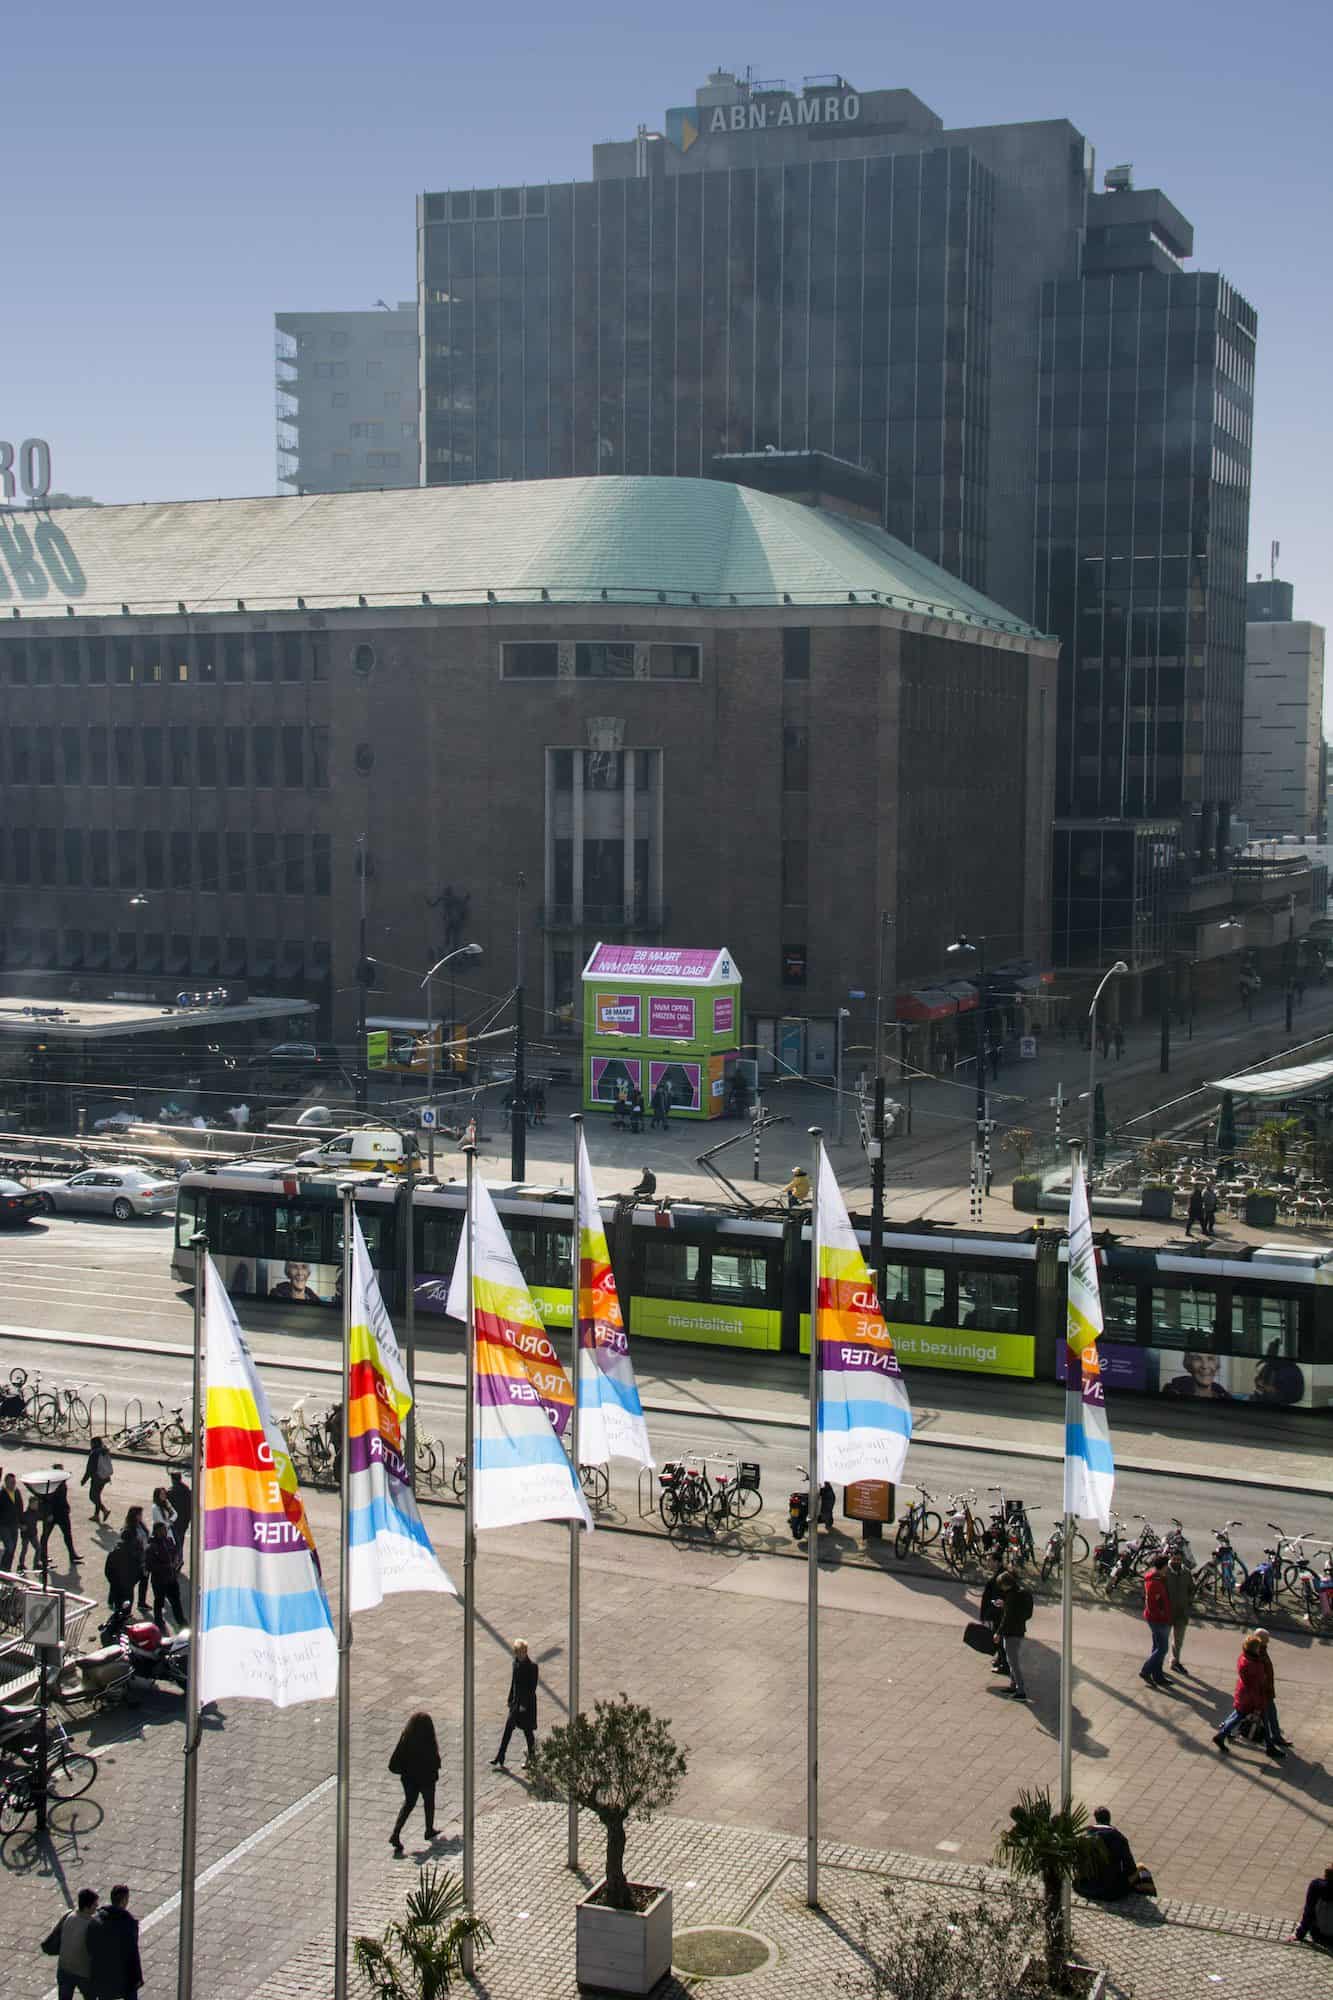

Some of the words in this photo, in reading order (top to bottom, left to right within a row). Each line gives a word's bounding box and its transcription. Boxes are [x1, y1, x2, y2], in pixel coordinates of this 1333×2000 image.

[649, 951, 682, 962] MAART
[623, 963, 647, 974] OPEN
[671, 1004, 689, 1012] OPEN
[667, 1313, 743, 1335] mentaliteit
[921, 1339, 997, 1362] bezuinigd
